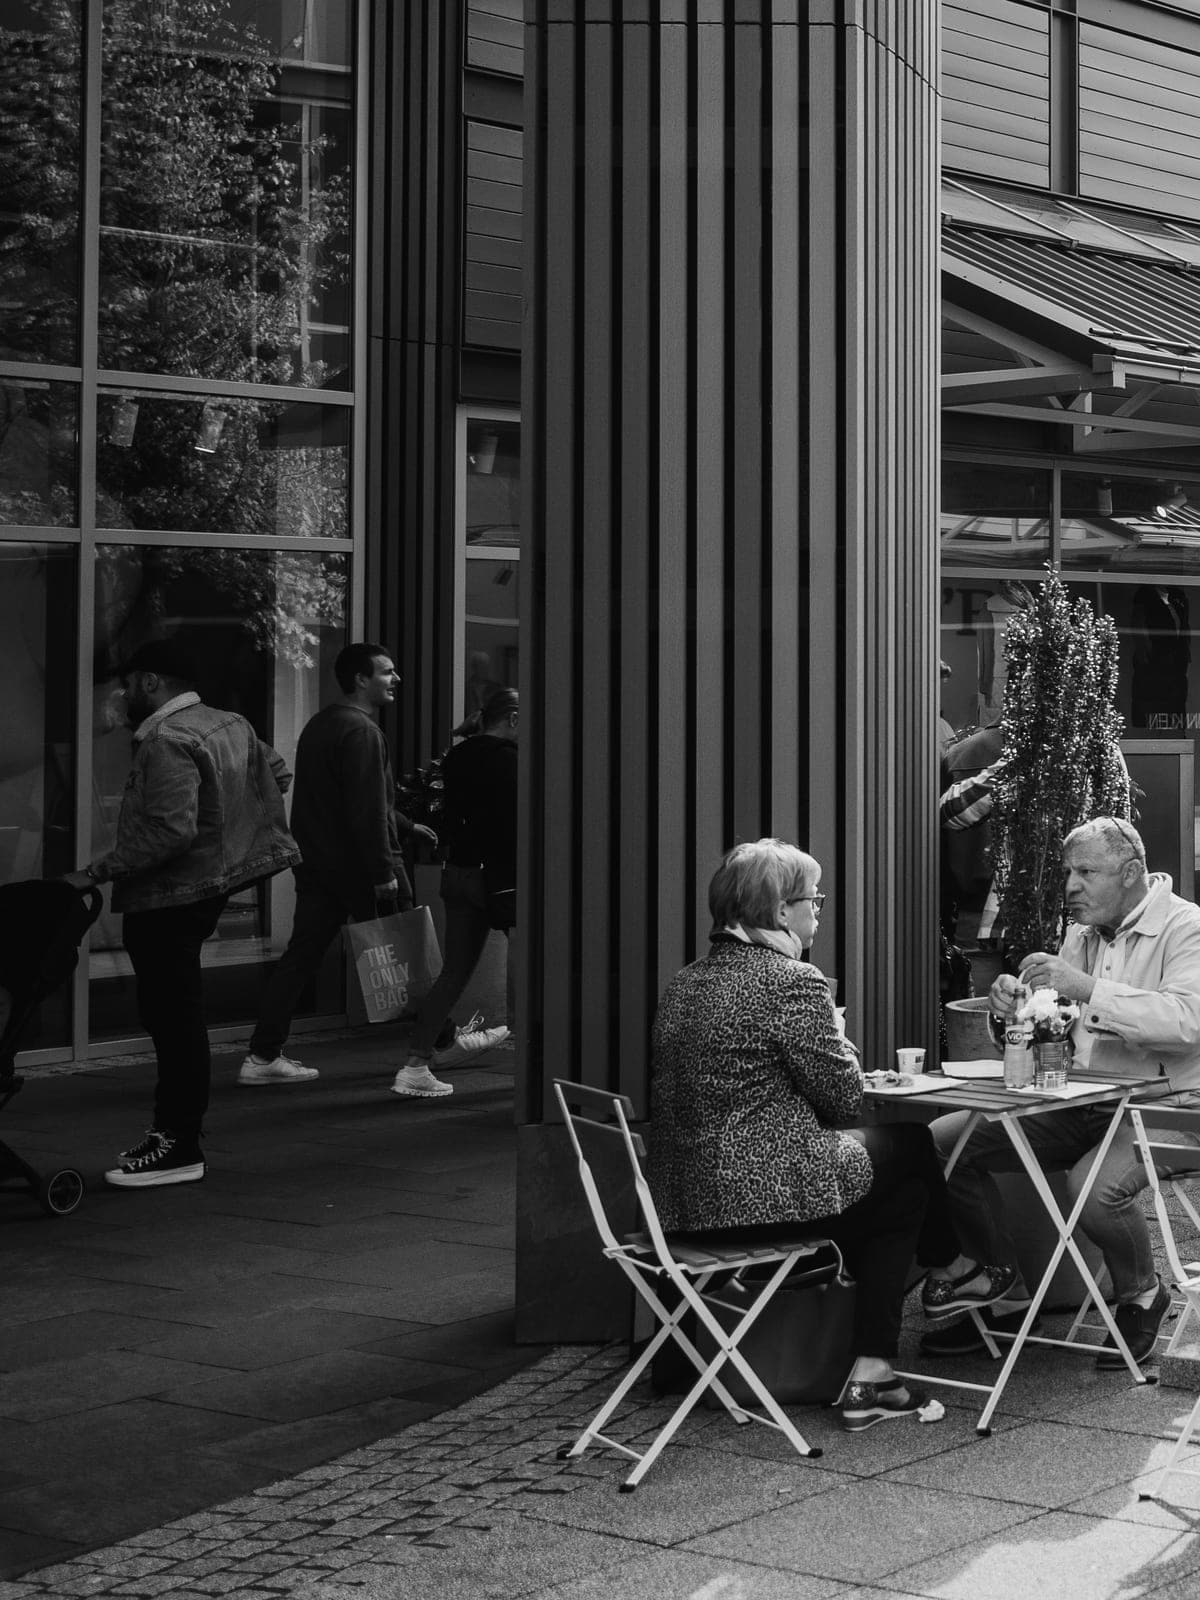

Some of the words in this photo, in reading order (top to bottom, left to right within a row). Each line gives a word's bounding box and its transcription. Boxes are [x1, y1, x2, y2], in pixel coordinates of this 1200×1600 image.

[363, 943, 398, 967] THE
[369, 961, 410, 989] ONLY
[374, 986, 409, 1011] BAG
